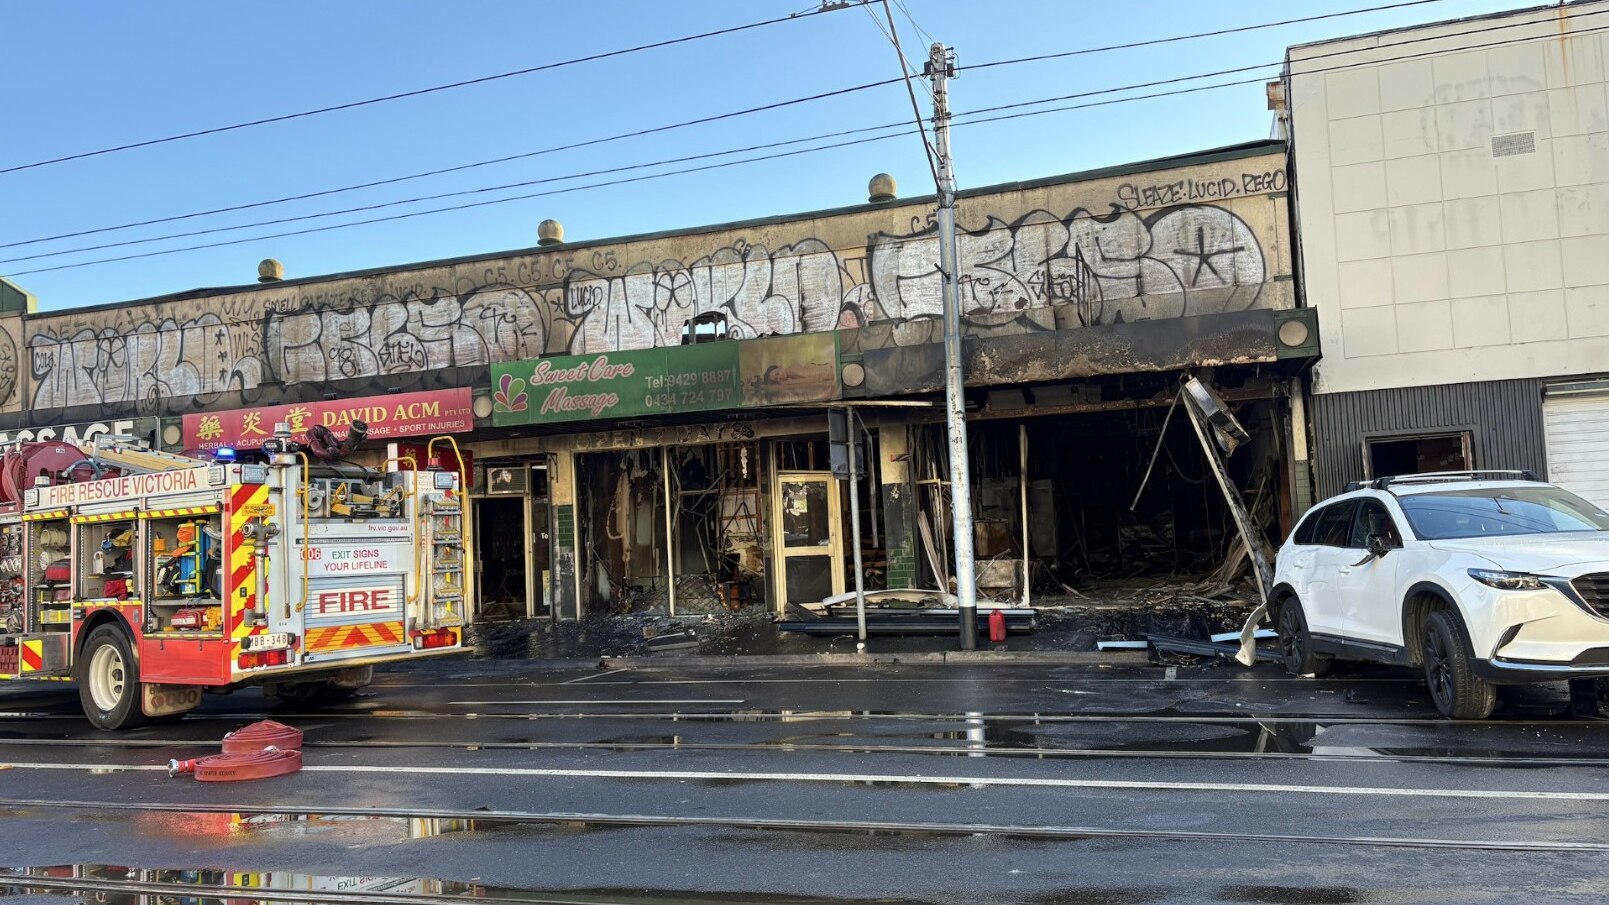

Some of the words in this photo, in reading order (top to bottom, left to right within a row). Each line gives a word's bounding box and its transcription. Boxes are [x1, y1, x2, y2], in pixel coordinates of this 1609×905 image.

[530, 360, 588, 386] Sweet
[588, 355, 635, 382] Care
[702, 369, 731, 384] 8887
[540, 386, 620, 417] Massage
[322, 406, 388, 427] DAVID
[393, 401, 440, 421] ACM
[399, 423, 426, 433] SPORT
[428, 420, 465, 430] INJURIES
[50, 486, 75, 505] FIRE
[79, 478, 129, 501] RESCUE
[132, 469, 196, 494] VICTORIA
[368, 524, 408, 533] frv.vic.gov.au
[332, 550, 351, 560] EXIT
[353, 549, 379, 559] SIGNS
[324, 562, 350, 571] YOUR
[351, 560, 388, 570] LIFELINE
[319, 589, 390, 614] FIRE
